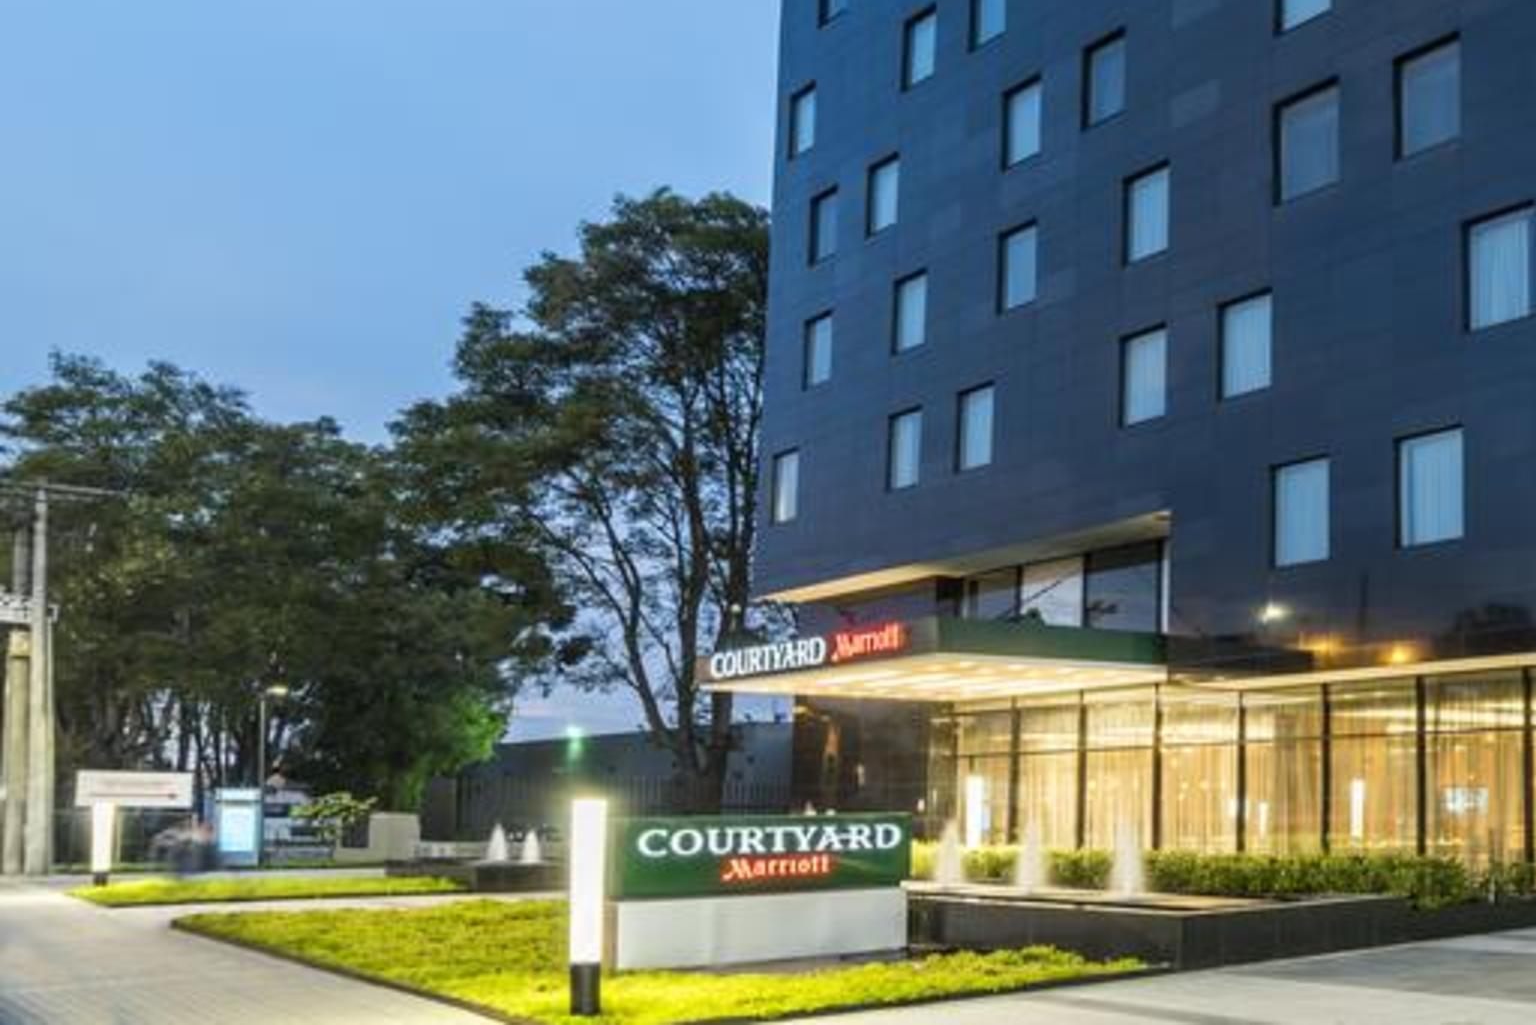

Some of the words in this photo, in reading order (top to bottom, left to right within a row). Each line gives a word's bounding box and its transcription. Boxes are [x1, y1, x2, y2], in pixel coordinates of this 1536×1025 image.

[710, 636, 826, 678] COURTYARD
[831, 623, 903, 662] Marriott
[637, 823, 902, 858] COURTYARD
[722, 855, 830, 880] Marriott
